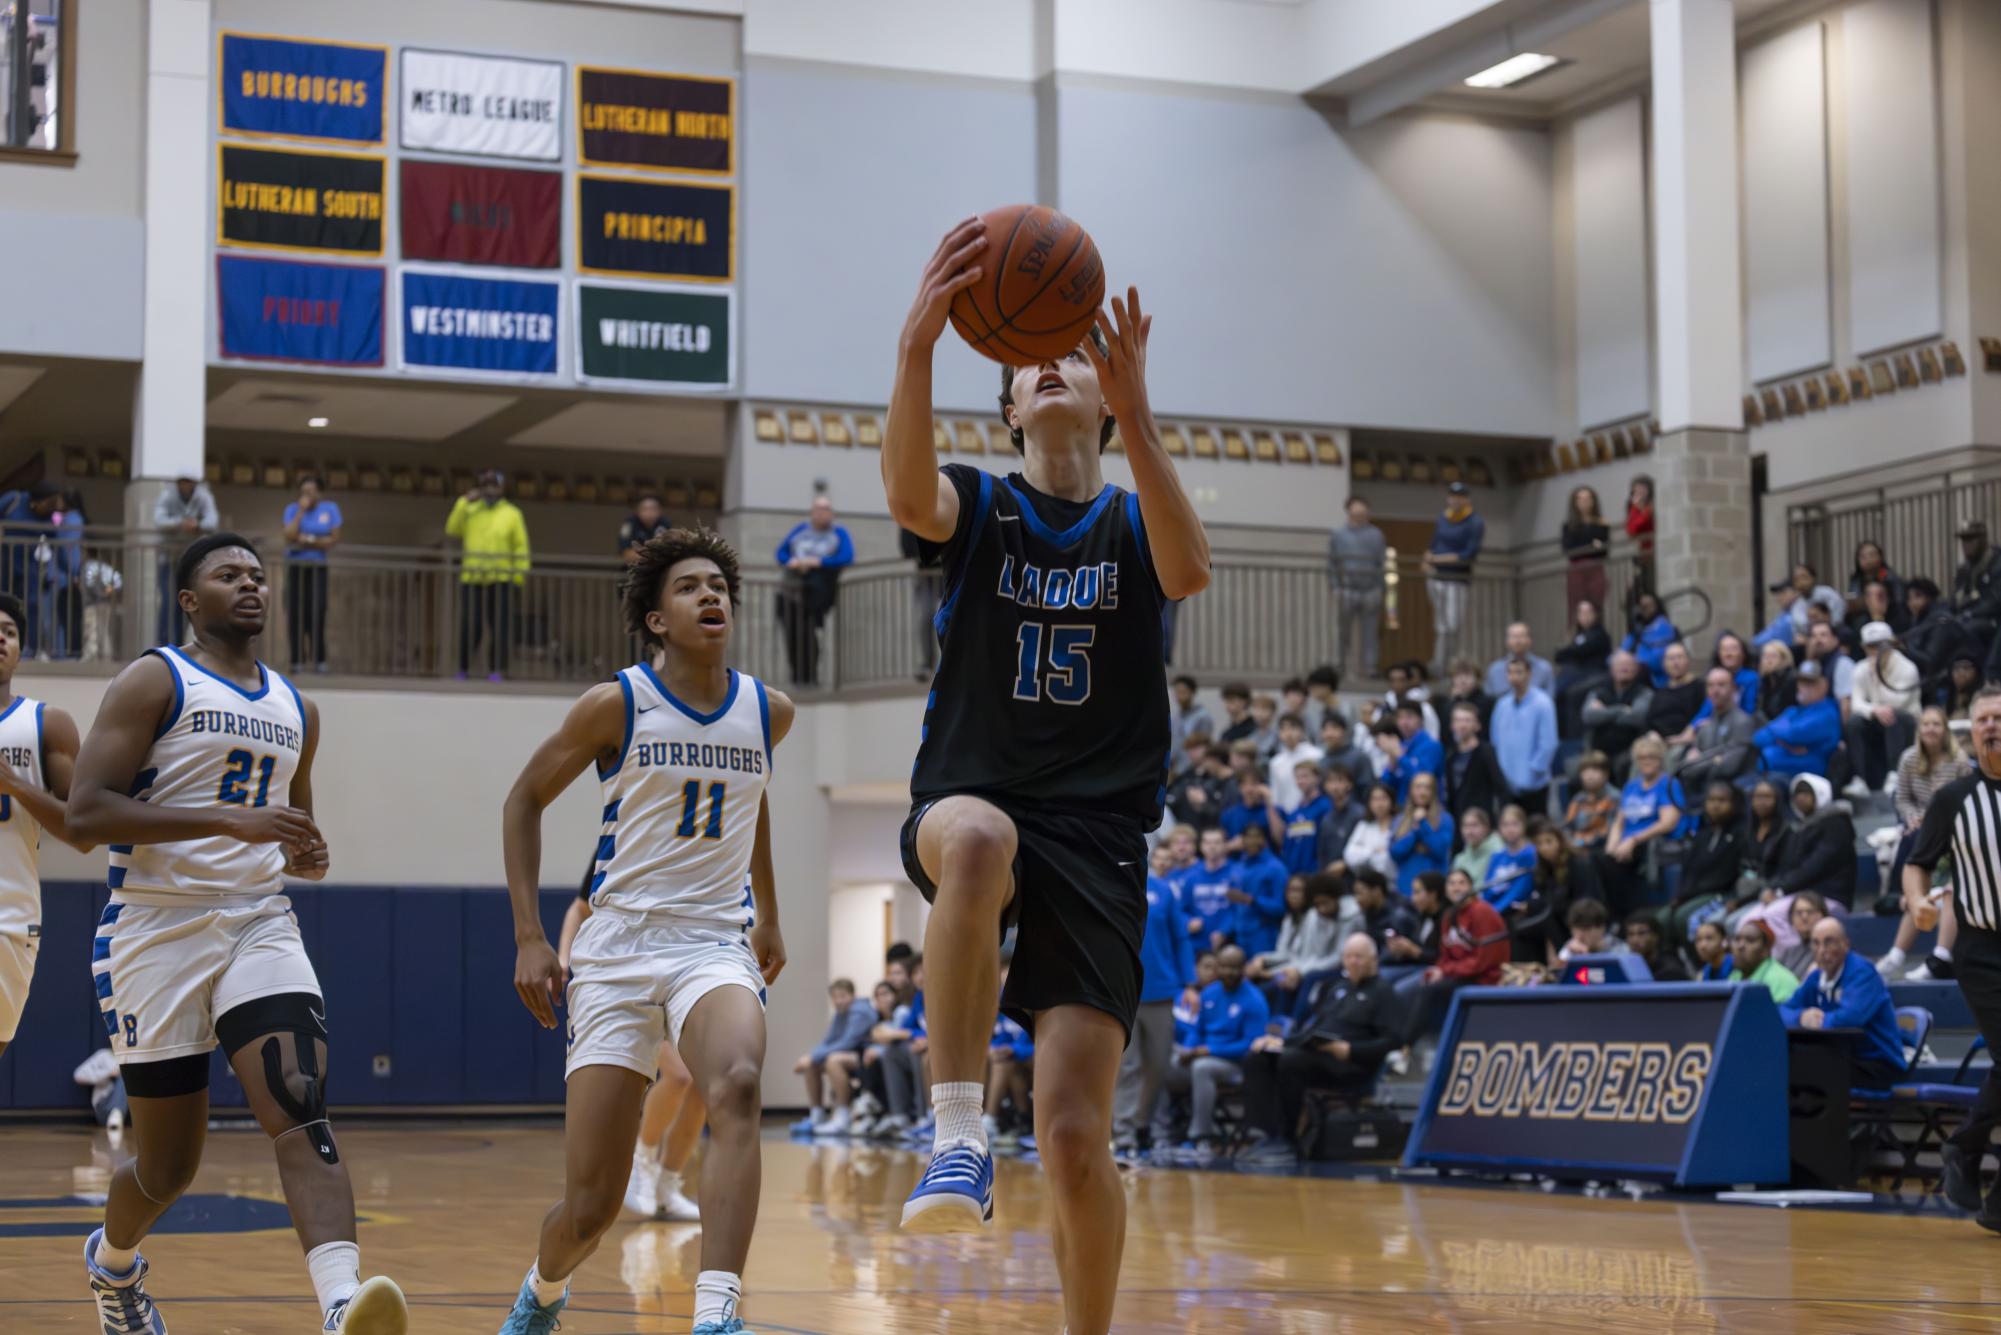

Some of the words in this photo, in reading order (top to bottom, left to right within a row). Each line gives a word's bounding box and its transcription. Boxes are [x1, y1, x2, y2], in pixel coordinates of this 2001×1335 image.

[241, 70, 367, 108] BURROUGHS
[411, 89, 472, 116] METRO
[484, 95, 554, 123] LEAGUE
[583, 102, 670, 137] LUTHERAN
[675, 110, 727, 140] NORTH
[224, 179, 317, 217] LUTHERAN
[322, 189, 381, 220] SOUTH
[604, 211, 707, 245] PRINCIPIA
[263, 296, 340, 328] PRIORY
[410, 305, 553, 342] WESTMINSTER
[599, 317, 711, 353] WHITFIELD
[997, 552, 1118, 611] LADUE
[1013, 620, 1096, 706] 15
[192, 710, 300, 753] BURROUGHS
[217, 747, 278, 808] 21
[638, 742, 763, 775] BURROUGHS
[674, 777, 728, 841] 11
[1437, 1041, 1712, 1124] BOMBERS
